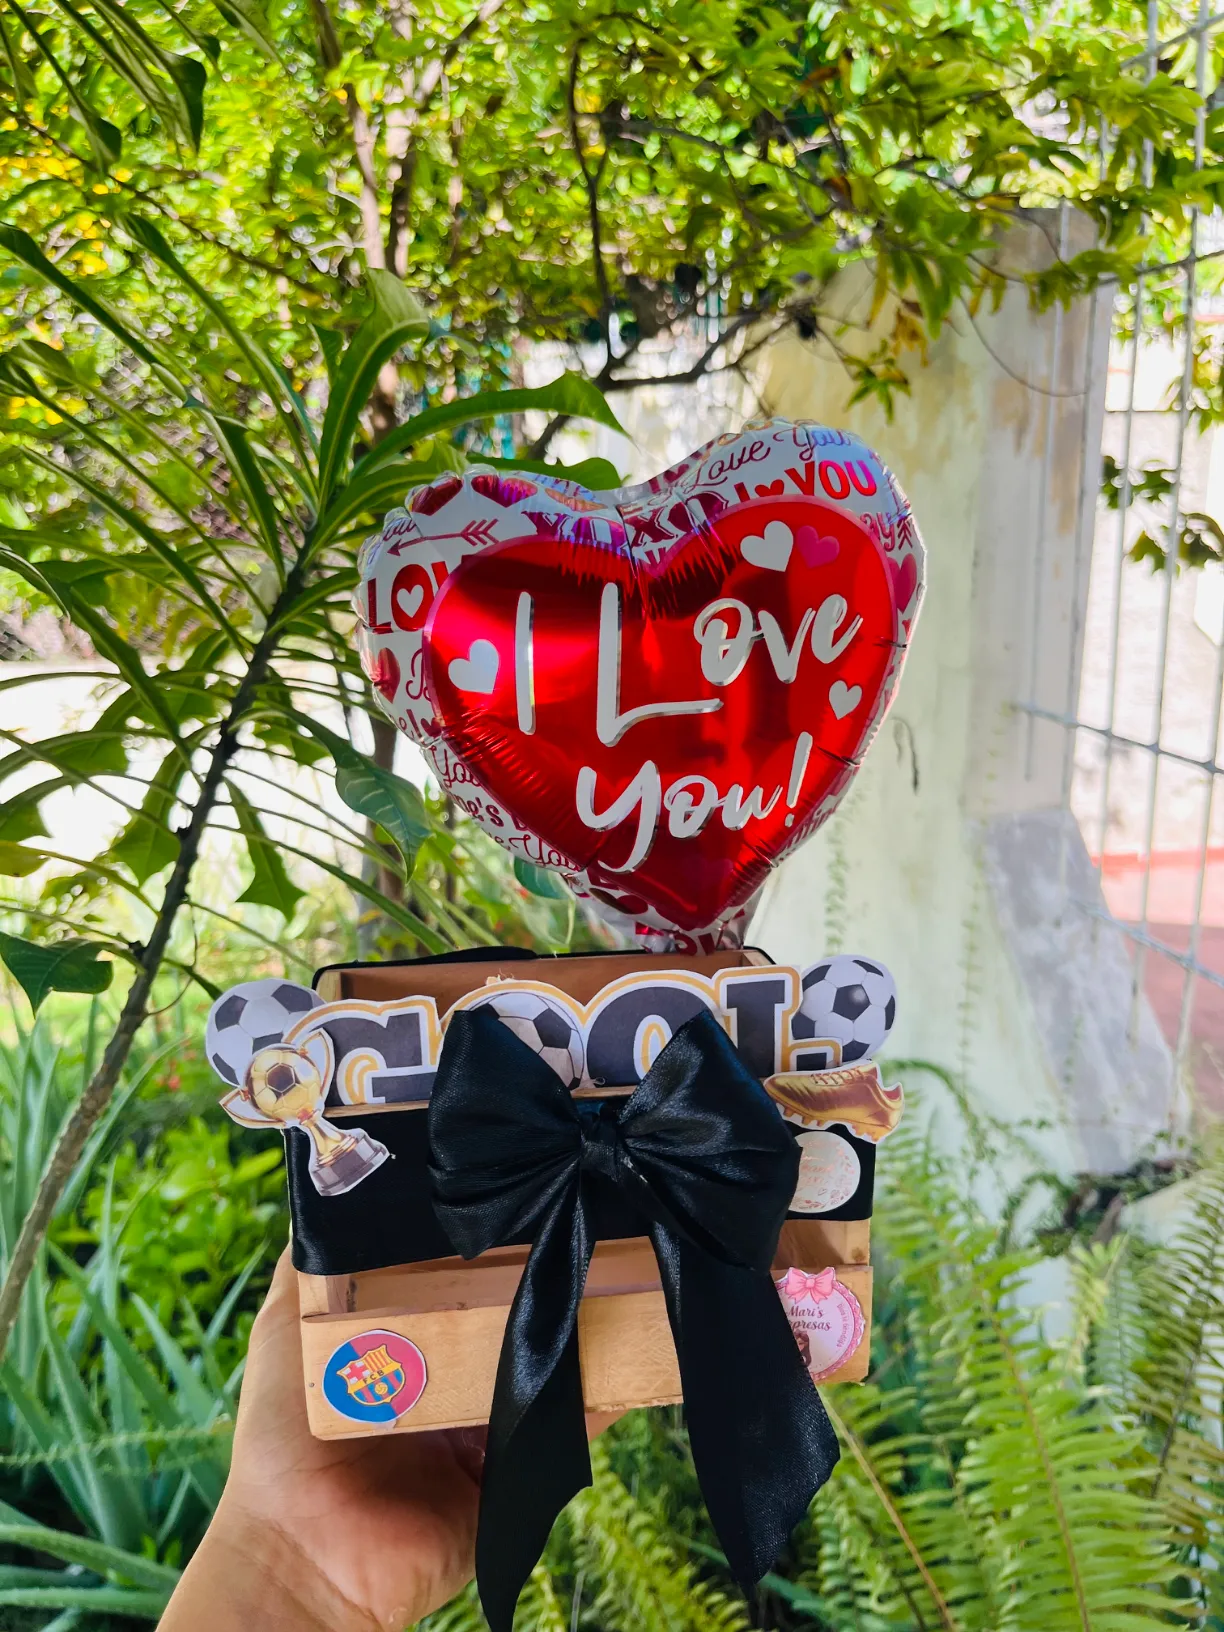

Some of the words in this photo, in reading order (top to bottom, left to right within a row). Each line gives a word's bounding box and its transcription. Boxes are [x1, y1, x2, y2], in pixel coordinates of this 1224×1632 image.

[683, 440, 772, 494] Love
[772, 418, 852, 461] You
[784, 459, 877, 500] YOU
[515, 590, 536, 735] I
[596, 581, 863, 748] Love
[575, 731, 813, 874] You!
[787, 1305, 824, 1319] Mari's
